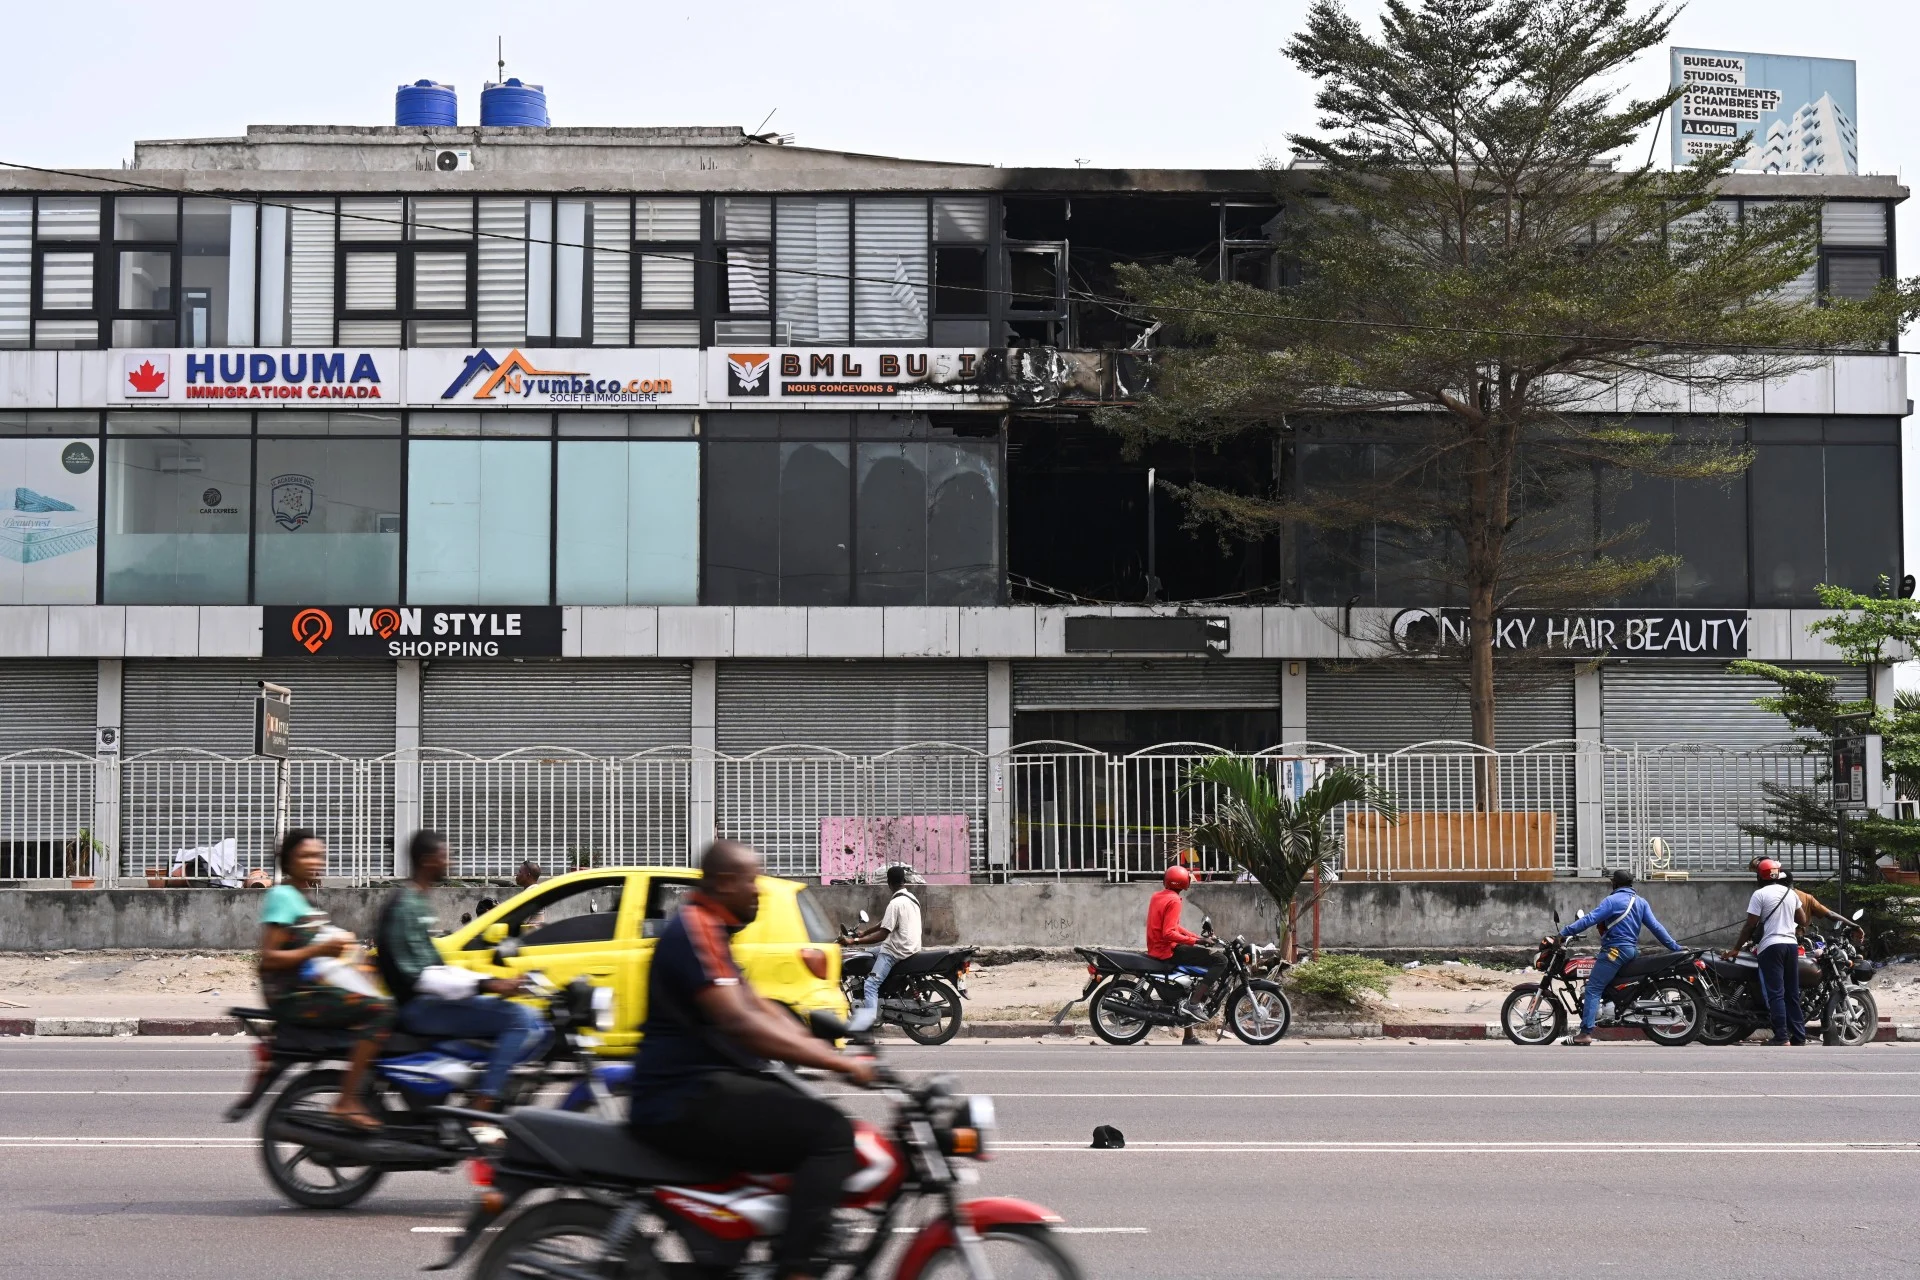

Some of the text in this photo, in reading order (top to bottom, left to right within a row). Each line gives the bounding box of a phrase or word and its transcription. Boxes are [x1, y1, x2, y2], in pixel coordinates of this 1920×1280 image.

[1684, 56, 1742, 71] BUREAUX,
[1684, 71, 1737, 84] STUDIOS,
[1685, 85, 1780, 101] APPARTEMENTS,
[1684, 95, 1775, 110] 2 CHAMBRES ET
[1684, 106, 1758, 119] 3 CHAMBRES
[1684, 121, 1734, 135] À LOUER
[186, 353, 381, 383] HUDUMA
[781, 353, 862, 377] BML
[186, 385, 381, 399] IMMIGRATION CANADA
[503, 374, 672, 398] Nyumbaco.com
[787, 384, 894, 393] NOUS CONCEVONS &
[550, 393, 657, 402] SOCIETE IMMOBILIERE
[433, 613, 522, 636] STYLE
[1546, 617, 1618, 649] HAIR
[1626, 618, 1747, 652] BEAUTY
[388, 641, 499, 657] SHOPPING
